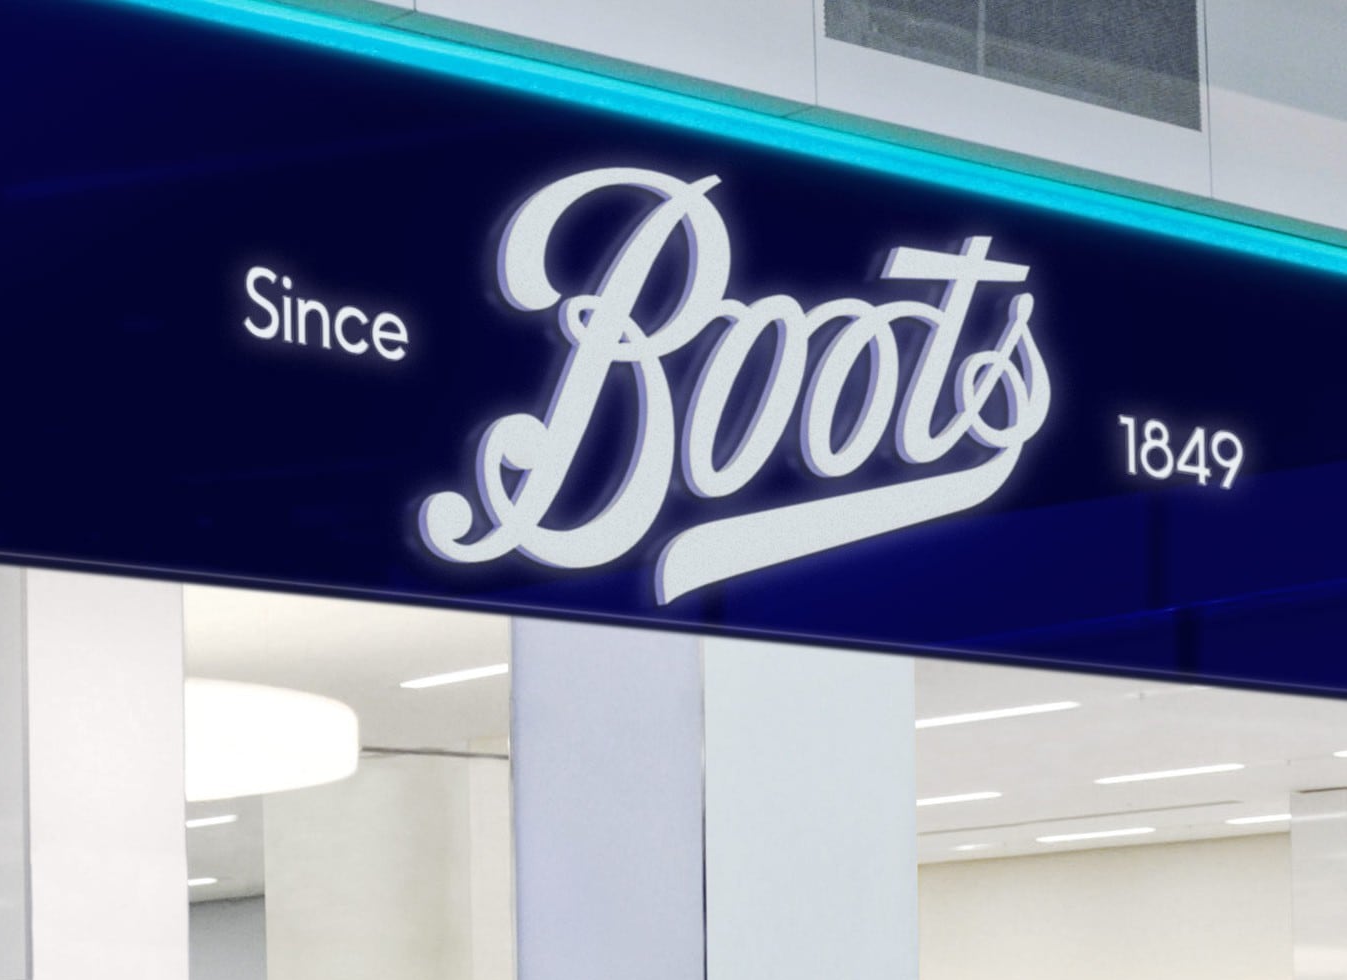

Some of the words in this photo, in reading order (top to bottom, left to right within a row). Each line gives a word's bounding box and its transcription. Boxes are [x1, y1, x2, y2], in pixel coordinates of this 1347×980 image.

[243, 266, 409, 361] Since
[420, 166, 1051, 606] Boots
[1118, 414, 1244, 490] 1849
